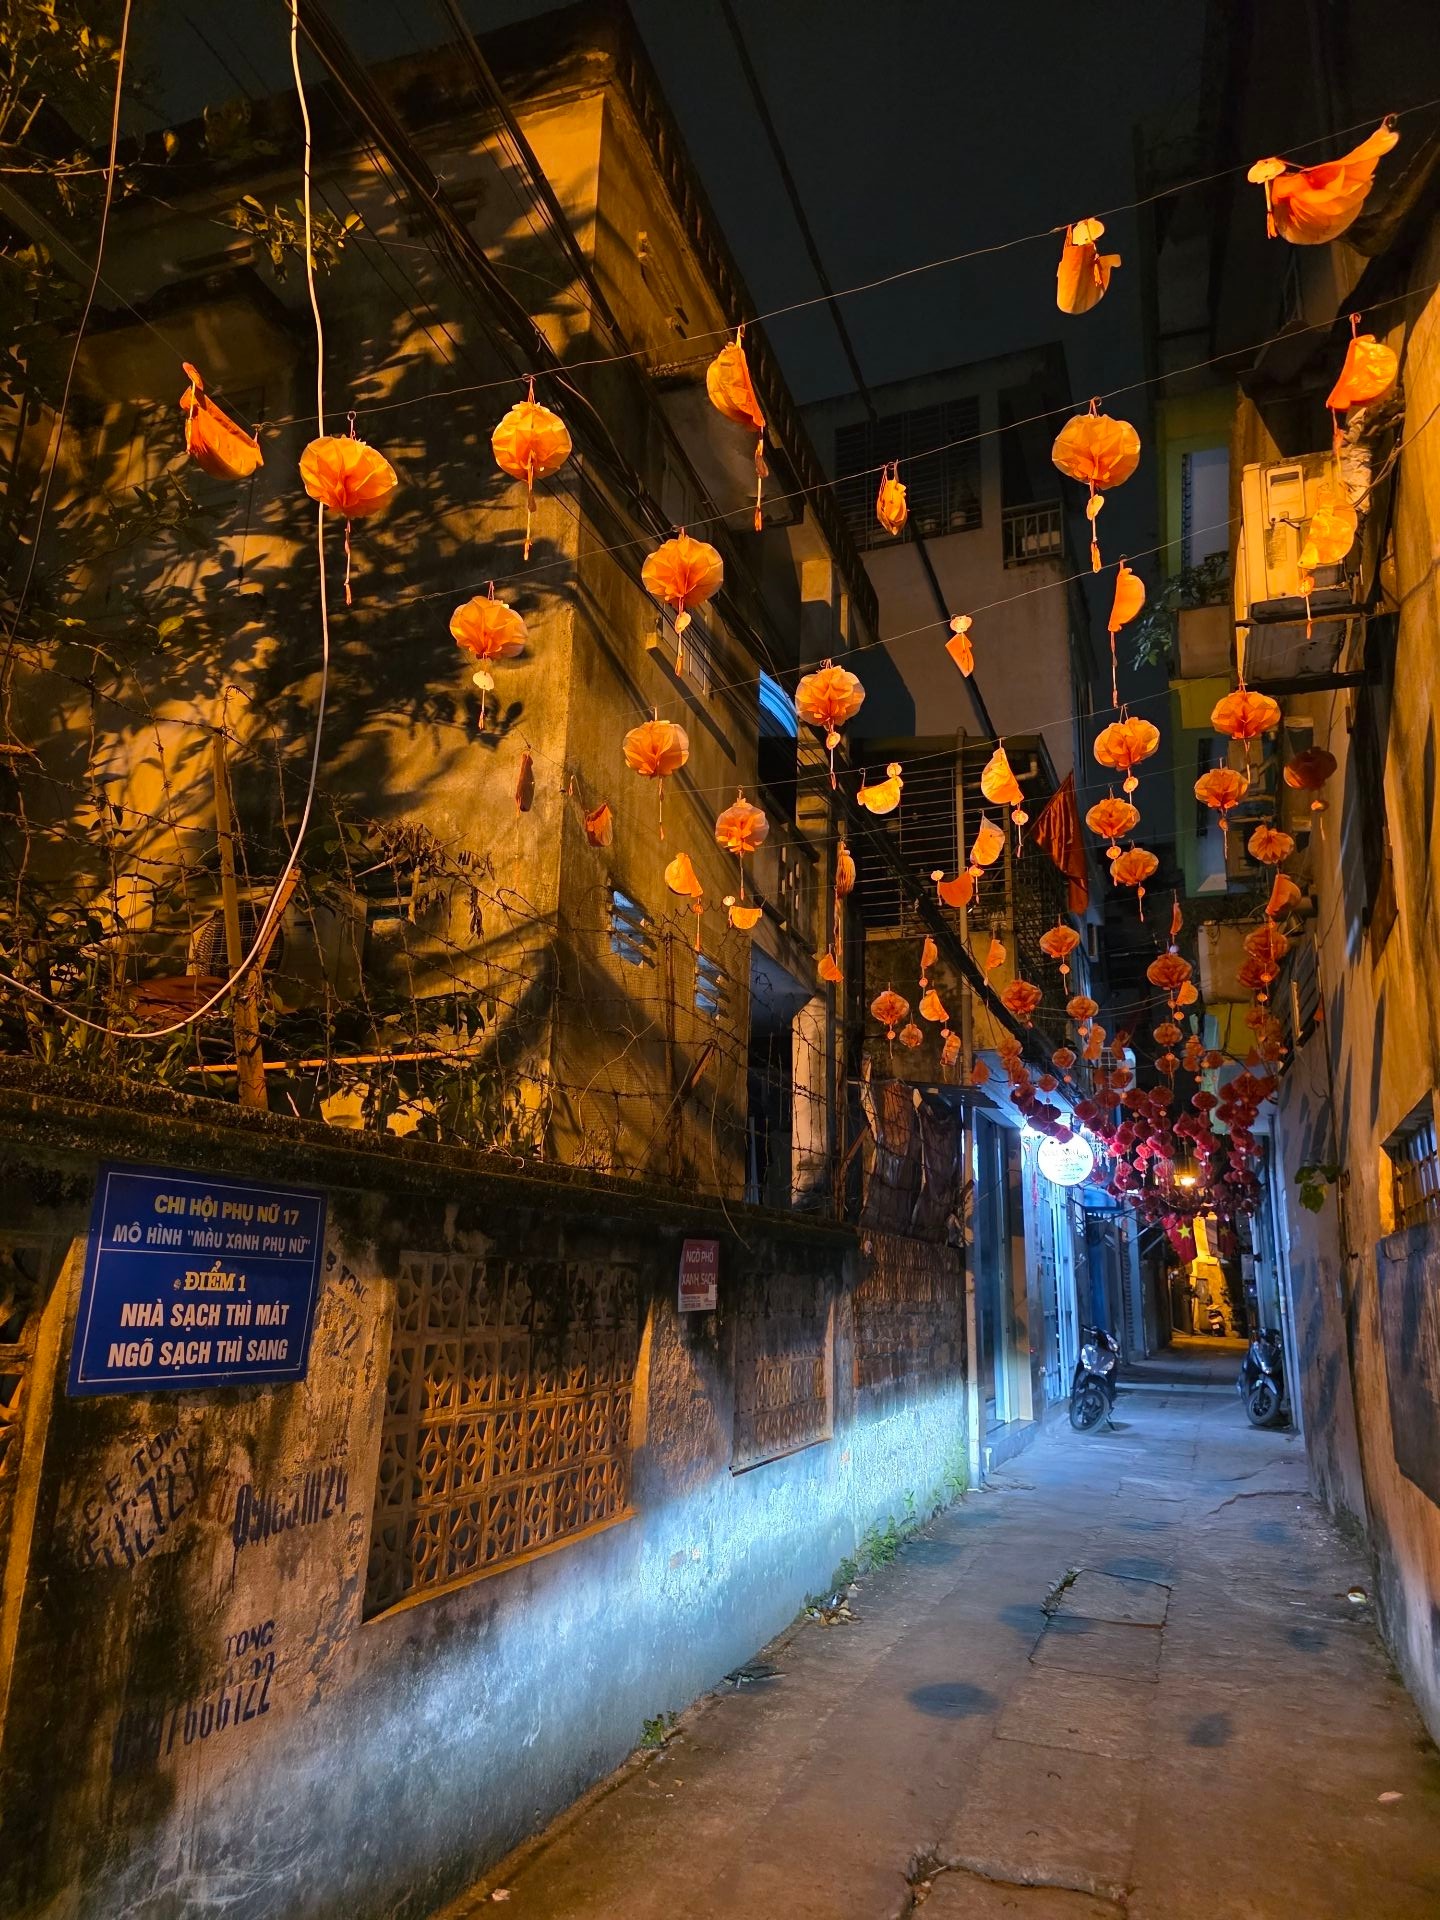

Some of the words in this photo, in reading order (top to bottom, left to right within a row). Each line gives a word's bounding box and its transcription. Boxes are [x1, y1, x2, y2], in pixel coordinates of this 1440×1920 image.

[154, 1194, 185, 1214] CHI
[190, 1195, 218, 1222] HỘI
[222, 1203, 254, 1226] PHỤ
[257, 1203, 280, 1224] NỮ
[283, 1209, 300, 1226] 17
[112, 1221, 142, 1243] MÔ
[146, 1227, 183, 1246] HÌNH
[225, 1233, 259, 1251] XANH
[263, 1234, 286, 1257] PHỤ
[184, 1259, 236, 1291] ĐIỂM
[238, 1274, 247, 1292] 1
[120, 1299, 164, 1327] NHÀ
[170, 1304, 221, 1332] SẠCH
[226, 1300, 252, 1326] THÌ
[255, 1301, 290, 1326] MÁT
[107, 1337, 154, 1368] NGÕ
[159, 1341, 212, 1371] SẠCH
[216, 1336, 242, 1363] THÌ
[246, 1339, 289, 1361] SANG
